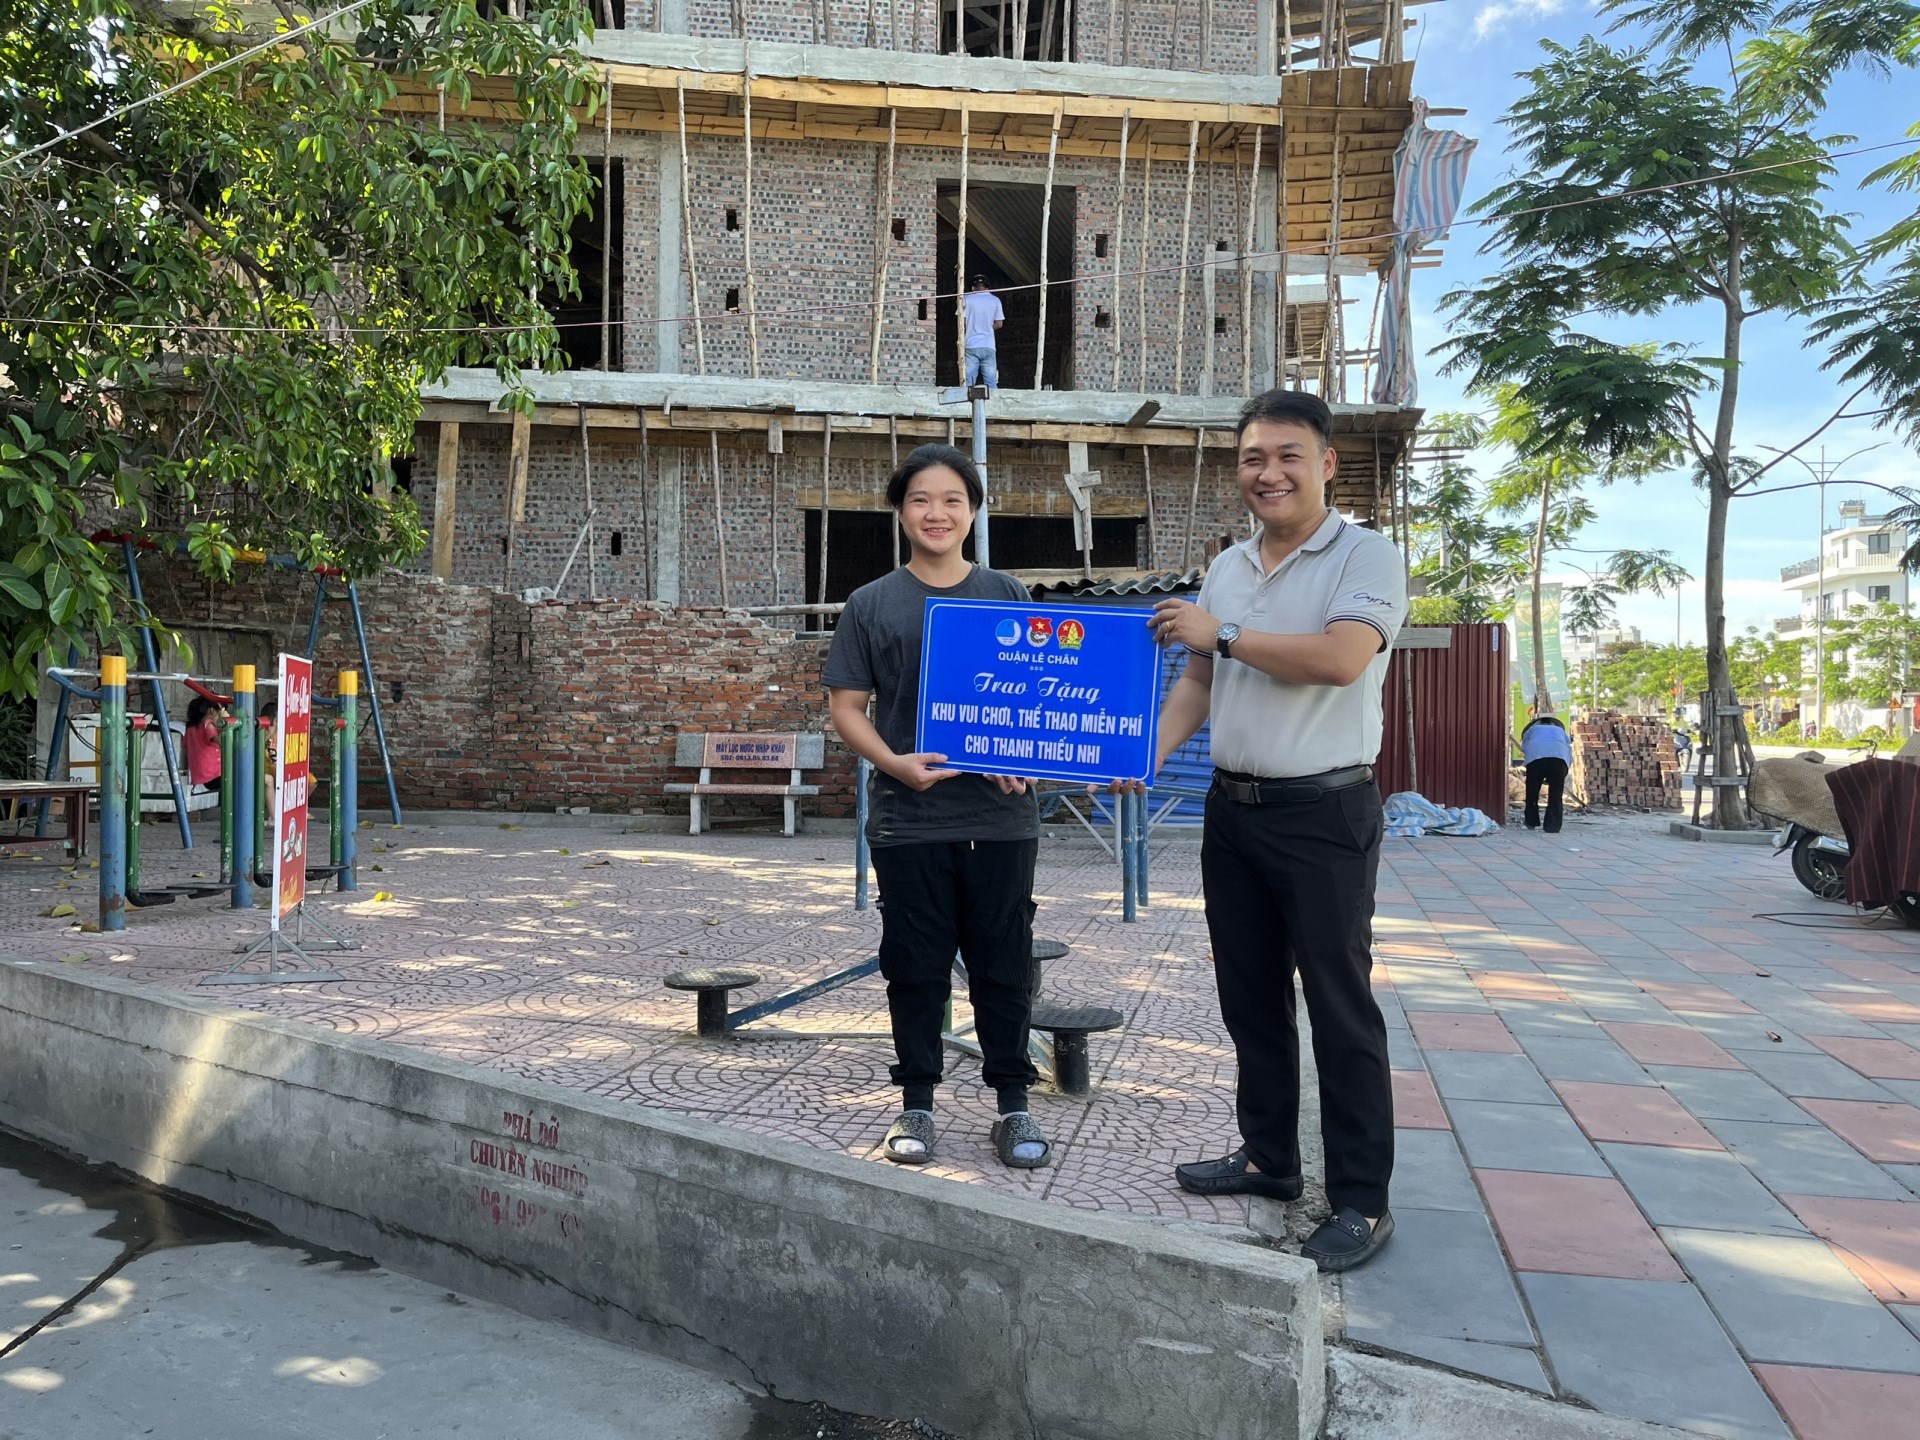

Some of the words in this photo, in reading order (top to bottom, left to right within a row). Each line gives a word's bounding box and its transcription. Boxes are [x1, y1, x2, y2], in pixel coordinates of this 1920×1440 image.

[998, 651, 1029, 663] QUẬN
[1031, 652, 1045, 664] LÊ
[1047, 653, 1079, 665] CHÂN
[973, 672, 1028, 695] Trao
[1037, 677, 1101, 704] Tặng
[931, 702, 955, 722] KHU
[959, 704, 978, 723] VUI
[1018, 703, 1041, 729] THỂ
[1044, 711, 1077, 732] THAO
[1081, 707, 1116, 735] MIỄN
[1119, 713, 1144, 737] PHÍ
[965, 734, 989, 755] CHO
[992, 737, 1033, 759] THANH
[1037, 736, 1073, 762] THIẾU
[1076, 744, 1101, 764] NHI
[503, 1110, 533, 1143] PHÁ
[470, 1139, 527, 1178] CHUYÊN
